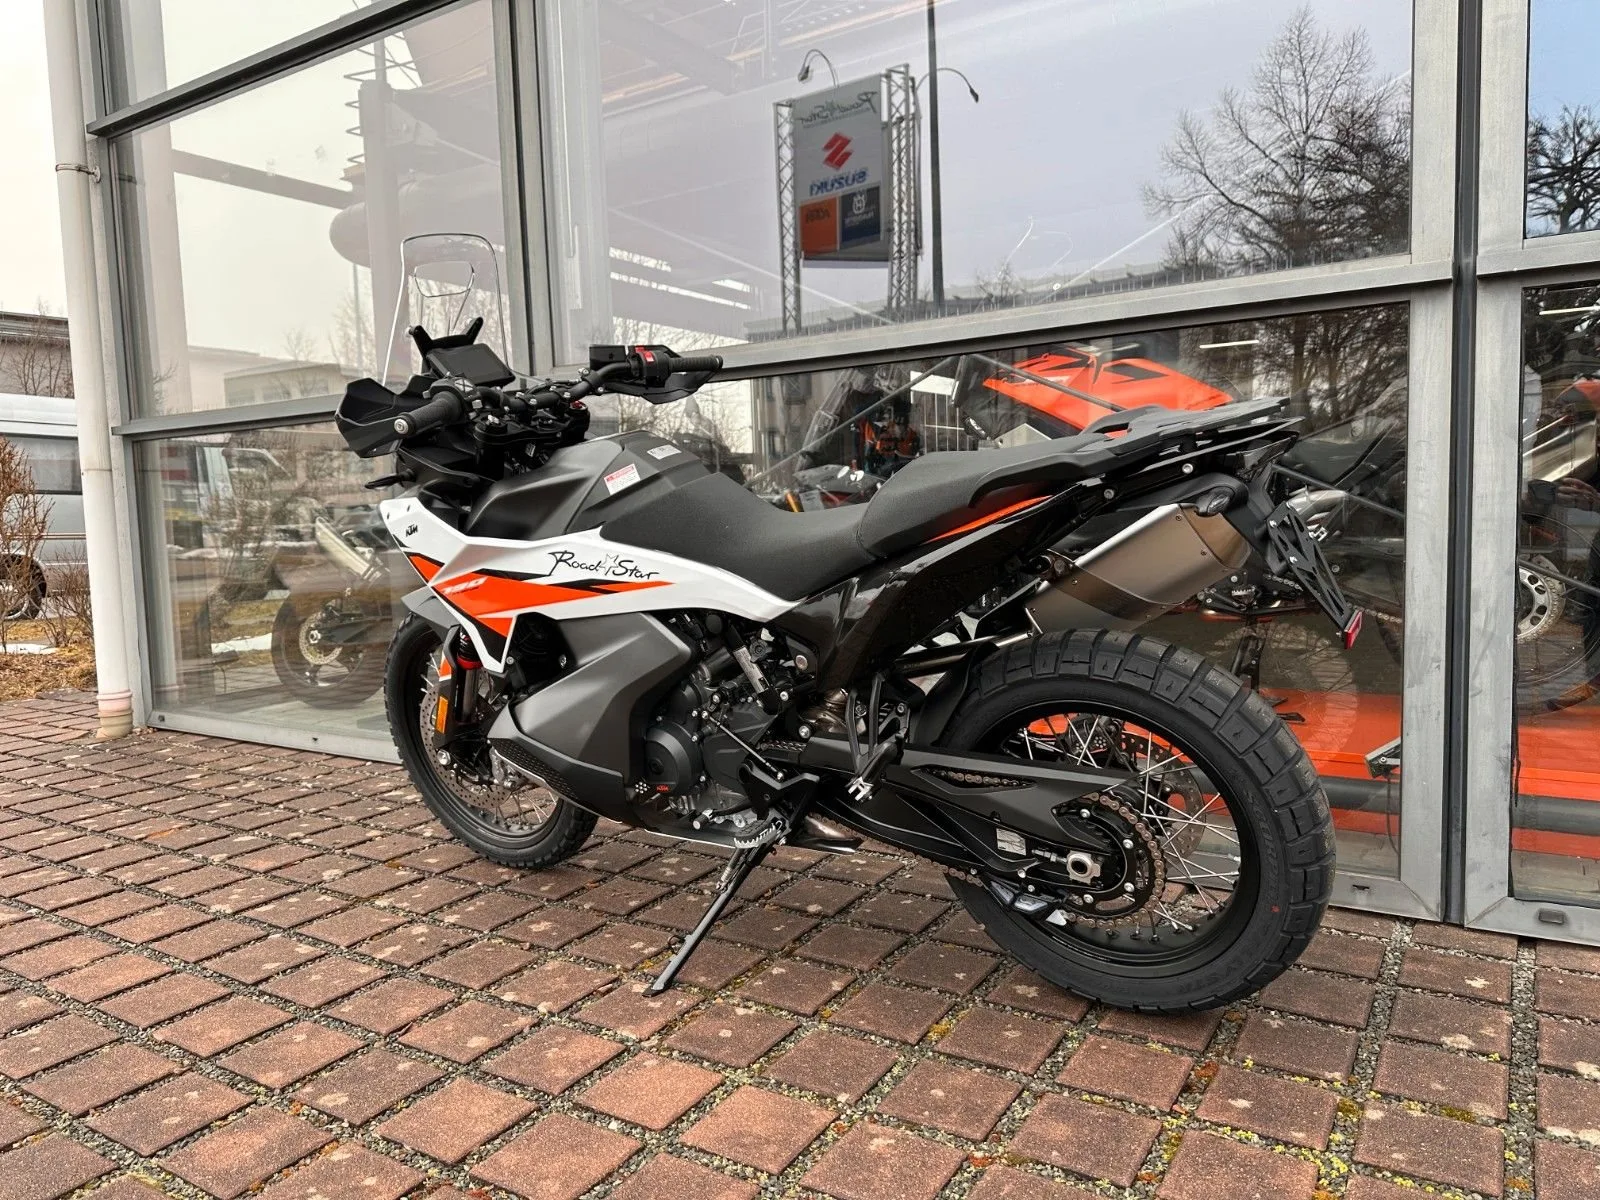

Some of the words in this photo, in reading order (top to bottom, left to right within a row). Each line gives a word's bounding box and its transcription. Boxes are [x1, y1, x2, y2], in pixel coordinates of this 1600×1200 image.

[405, 523, 419, 538] KTM
[547, 550, 602, 577] Road
[612, 560, 660, 579] Star
